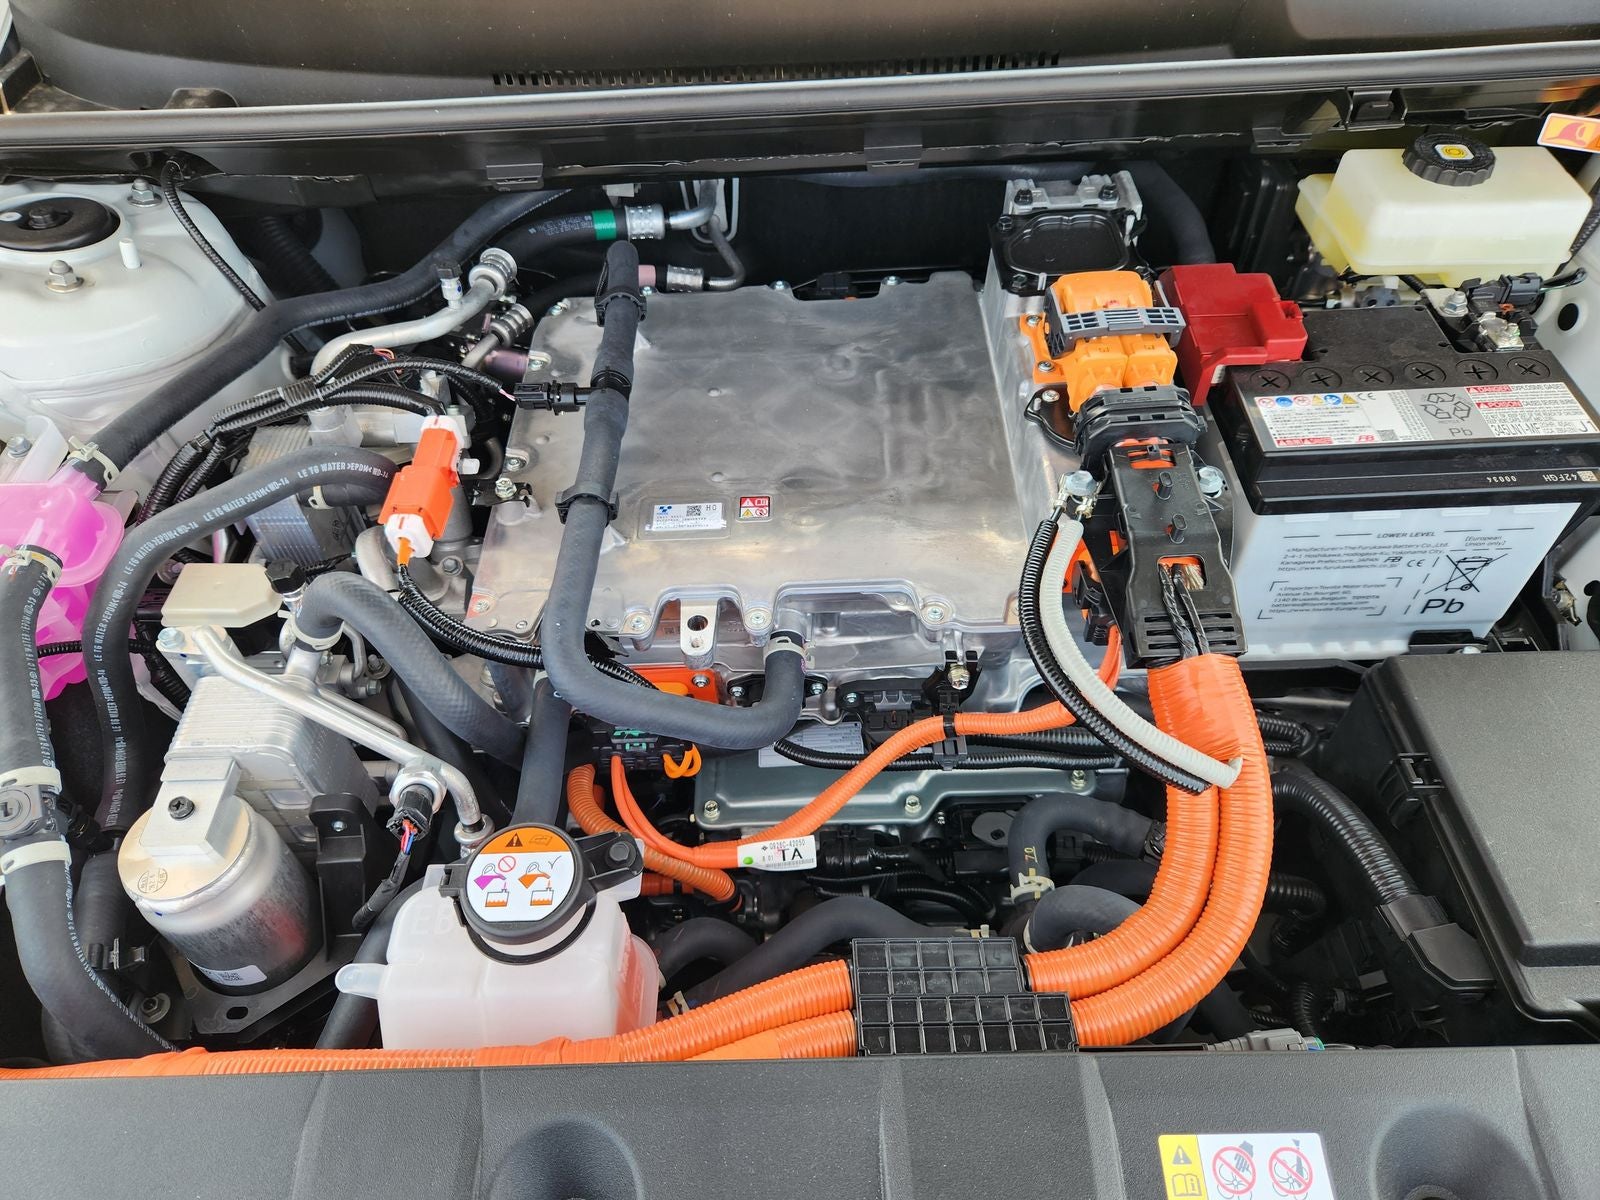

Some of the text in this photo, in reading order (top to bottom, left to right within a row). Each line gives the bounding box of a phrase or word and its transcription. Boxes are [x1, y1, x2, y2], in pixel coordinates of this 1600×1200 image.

[1357, 392, 1376, 401] CE
[1449, 427, 1472, 437] Pb
[320, 462, 346, 472] WATER
[222, 497, 248, 513] WATER
[134, 541, 156, 560] WATER
[1420, 598, 1465, 614] Pb
[94, 623, 107, 644] WATER
[778, 848, 803, 861] TA
